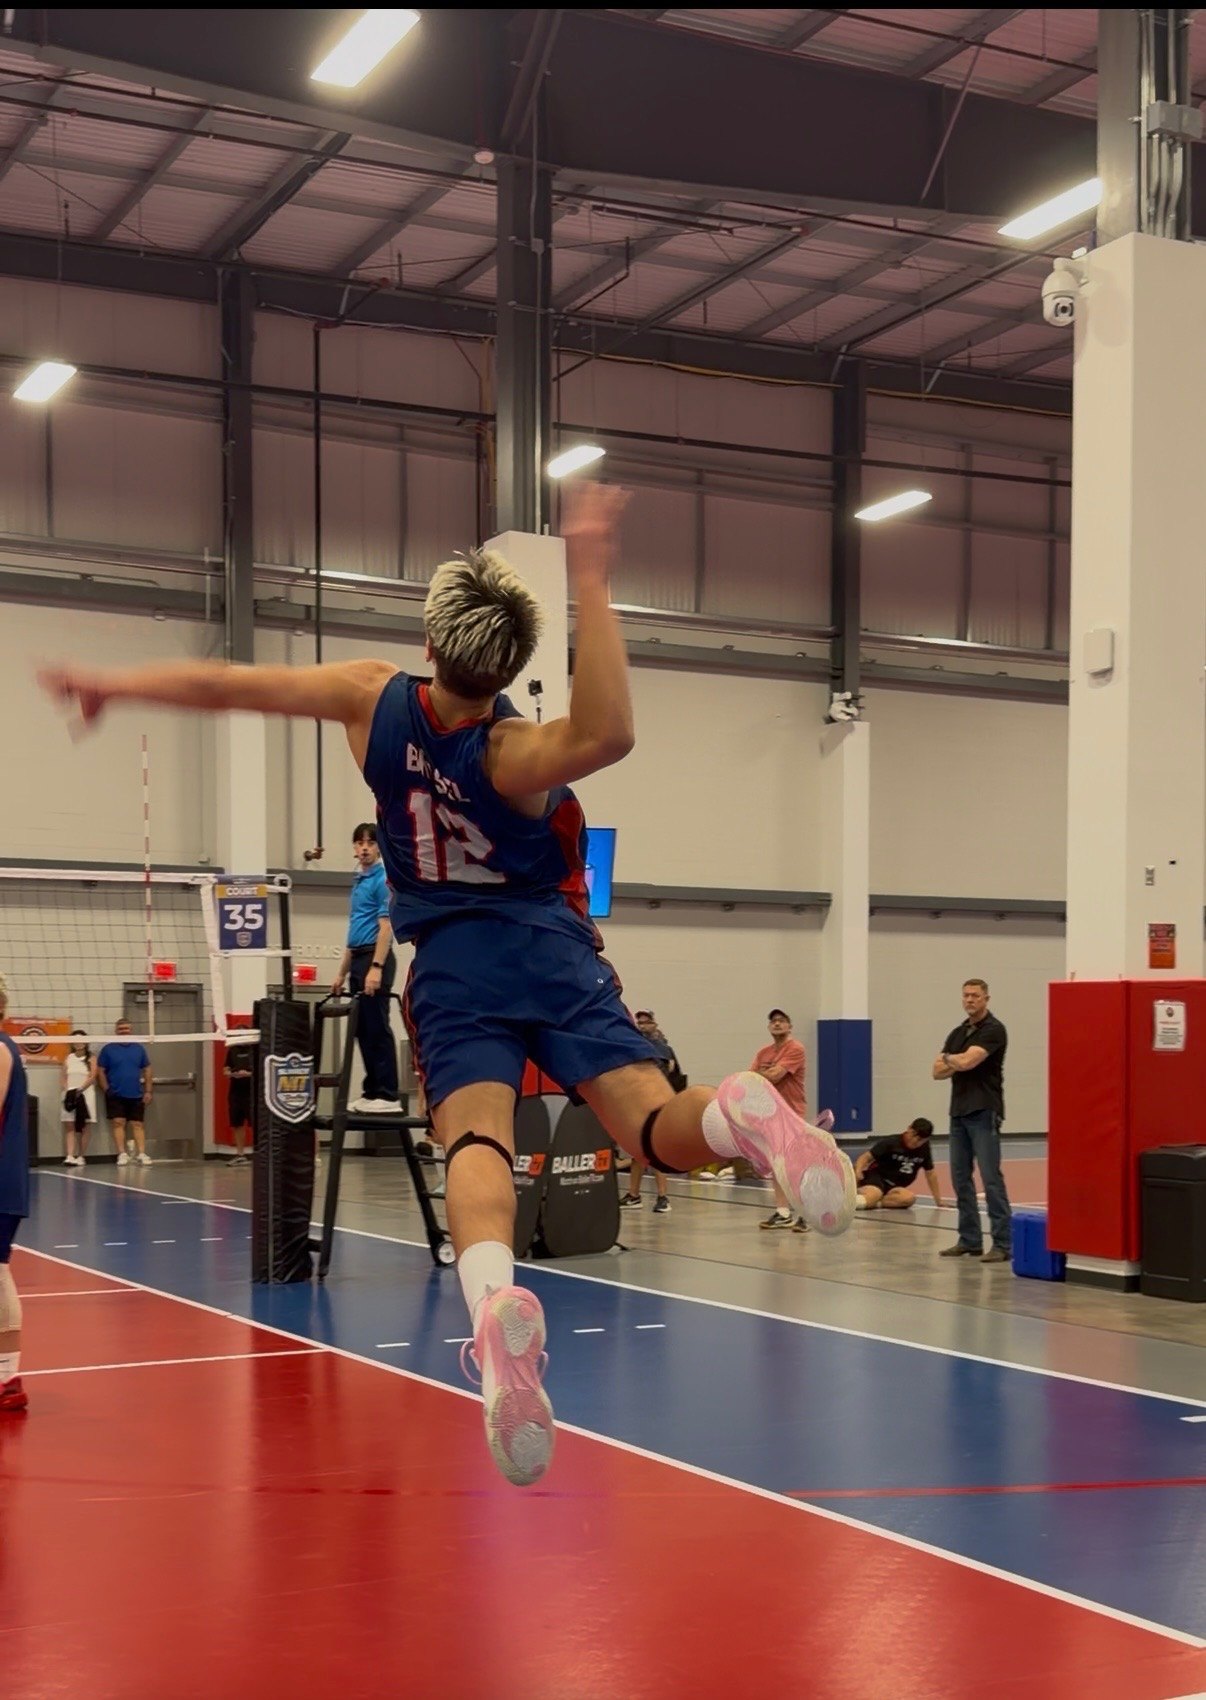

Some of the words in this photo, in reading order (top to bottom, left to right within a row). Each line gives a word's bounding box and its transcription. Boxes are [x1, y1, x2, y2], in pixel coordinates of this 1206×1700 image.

[408, 789, 507, 885] 12
[225, 886, 259, 896] COURT
[223, 903, 264, 930] 35
